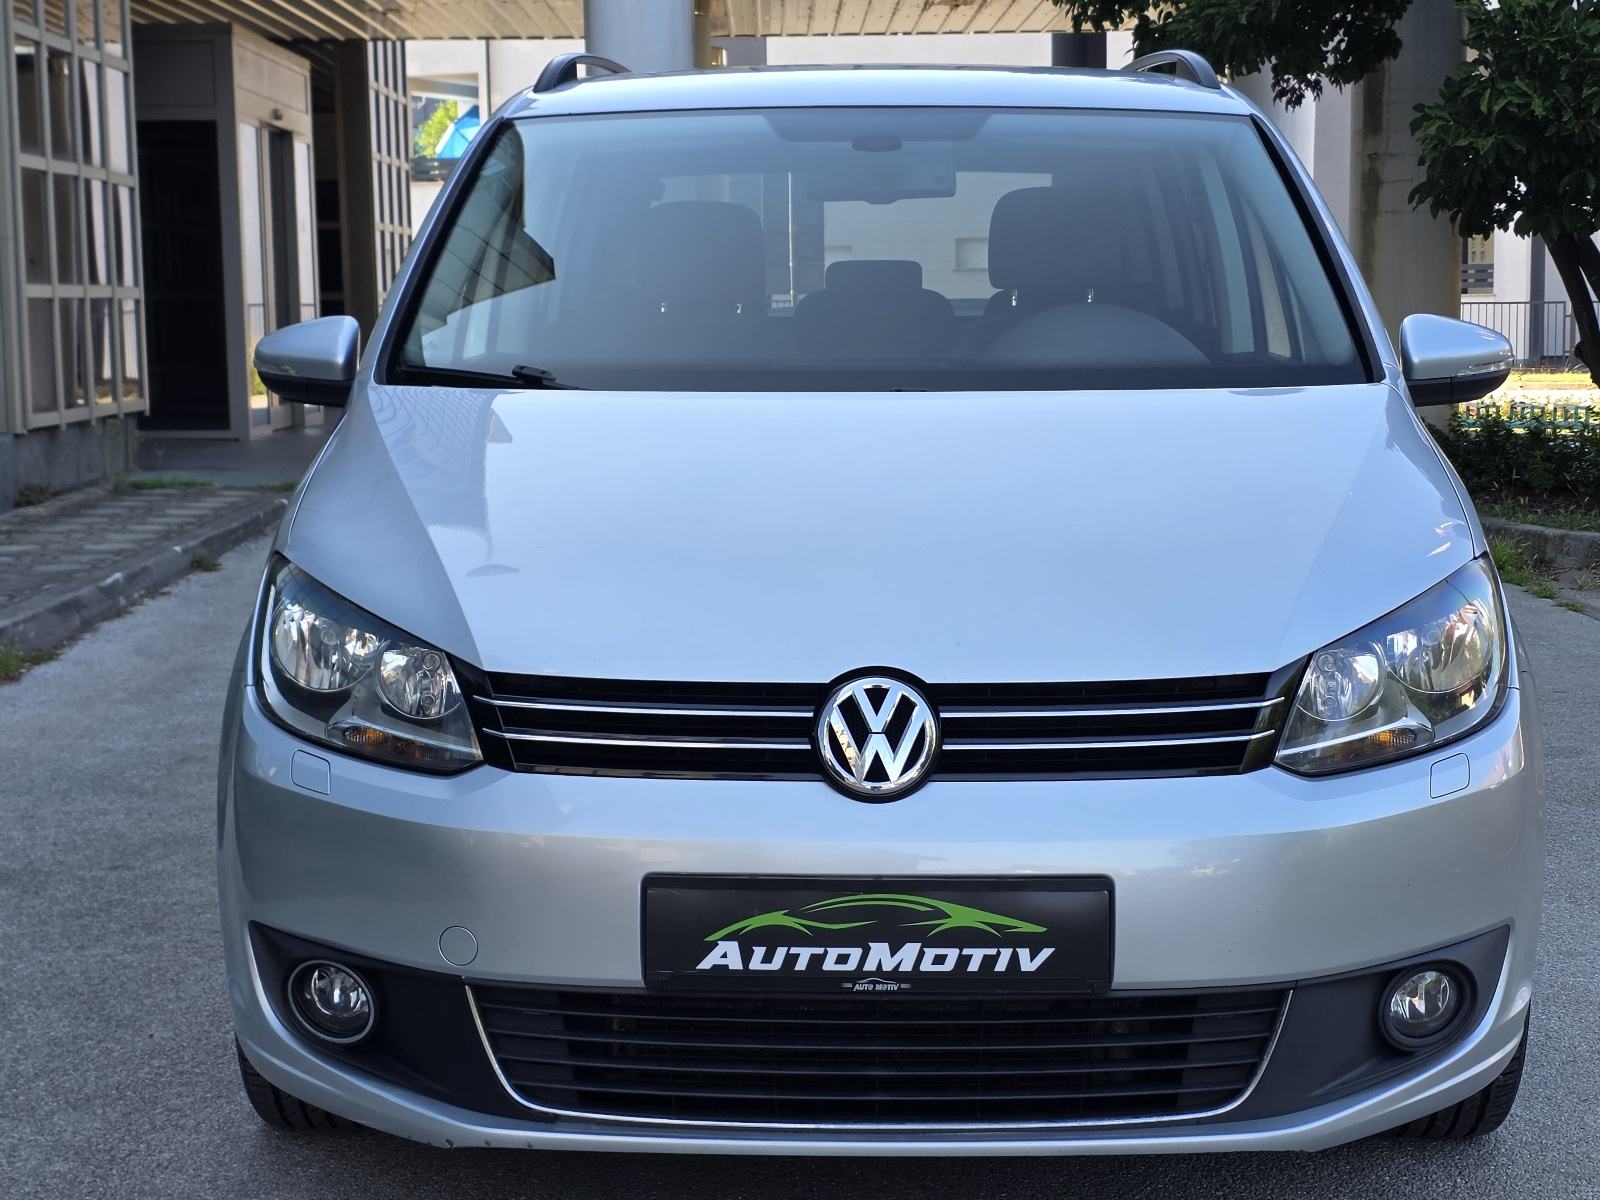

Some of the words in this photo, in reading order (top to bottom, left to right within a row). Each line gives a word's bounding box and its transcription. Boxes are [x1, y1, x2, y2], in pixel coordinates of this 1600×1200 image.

[826, 682, 929, 788] VW
[853, 983, 874, 992] AUTO
[875, 983, 899, 991] MOTIV
